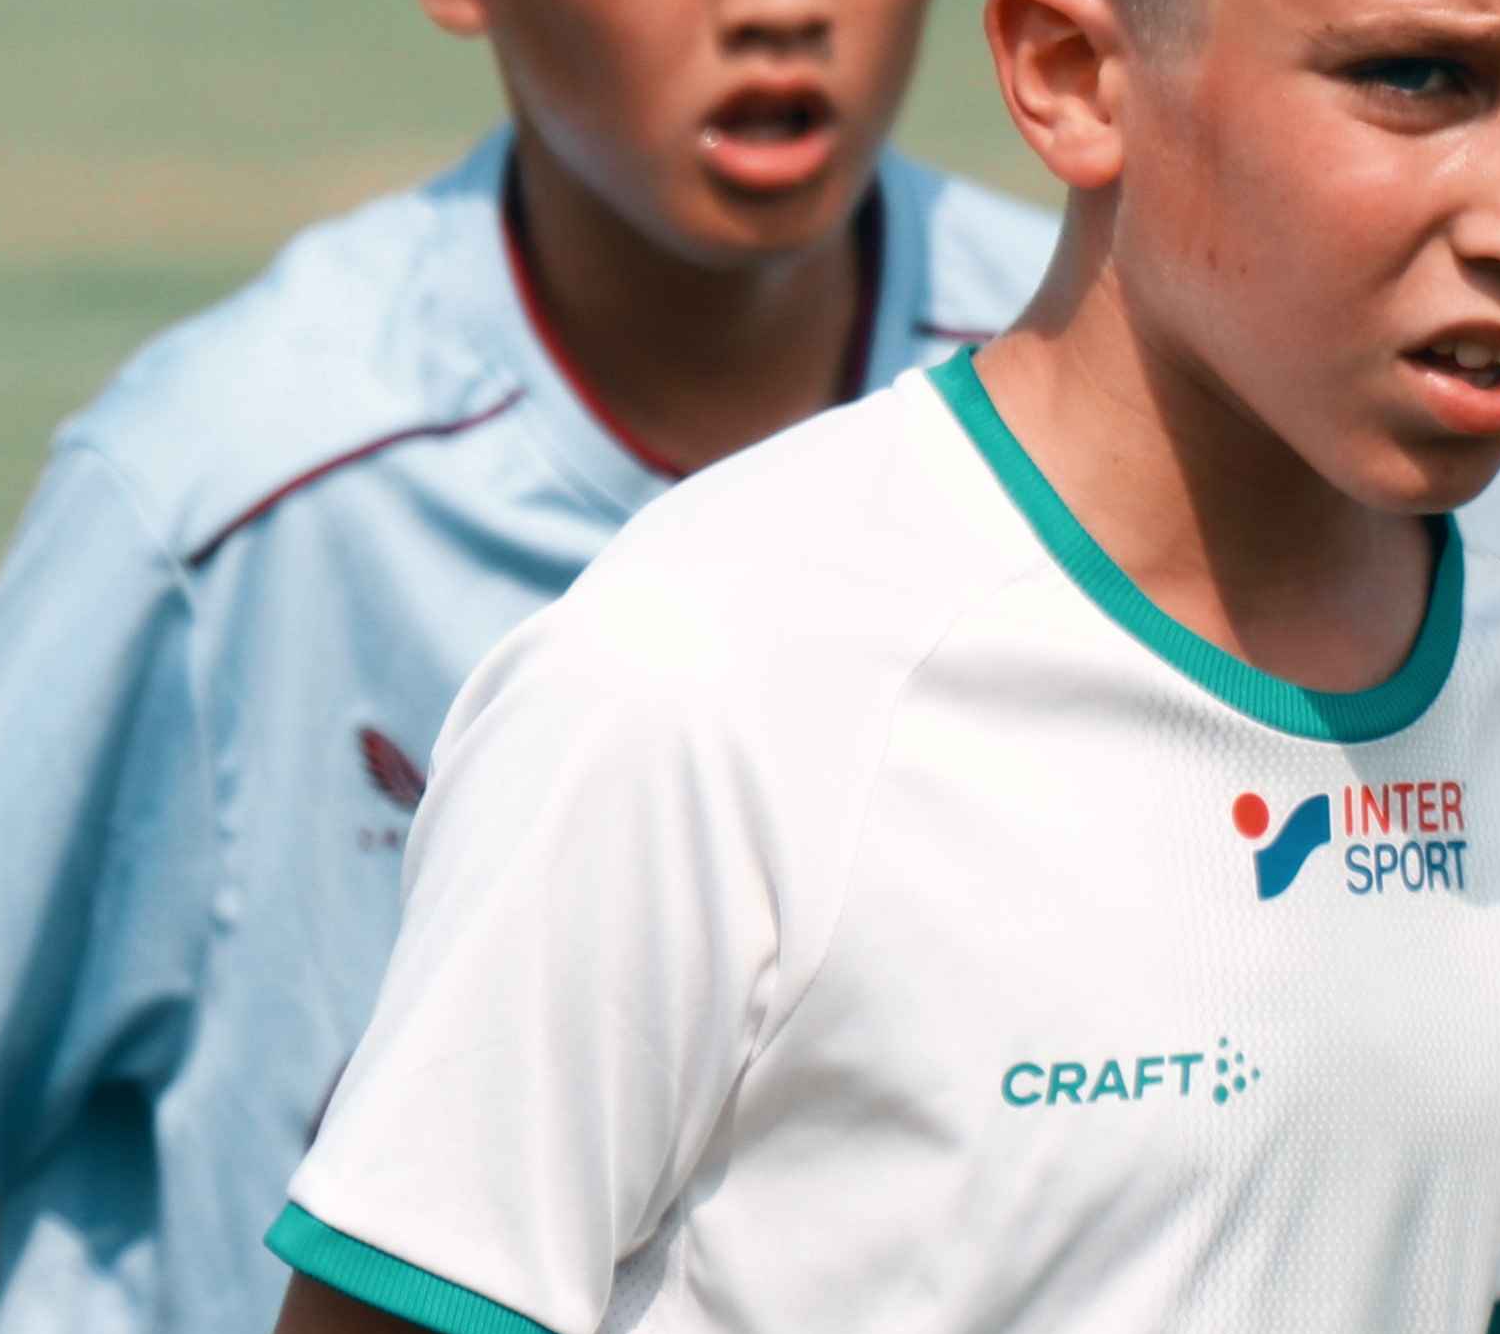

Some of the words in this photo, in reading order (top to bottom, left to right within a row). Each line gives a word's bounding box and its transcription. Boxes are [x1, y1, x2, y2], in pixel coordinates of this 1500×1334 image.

[1343, 780, 1465, 837] INTER
[1344, 839, 1467, 896] SPORT
[1000, 1052, 1205, 1108] CRAFT
